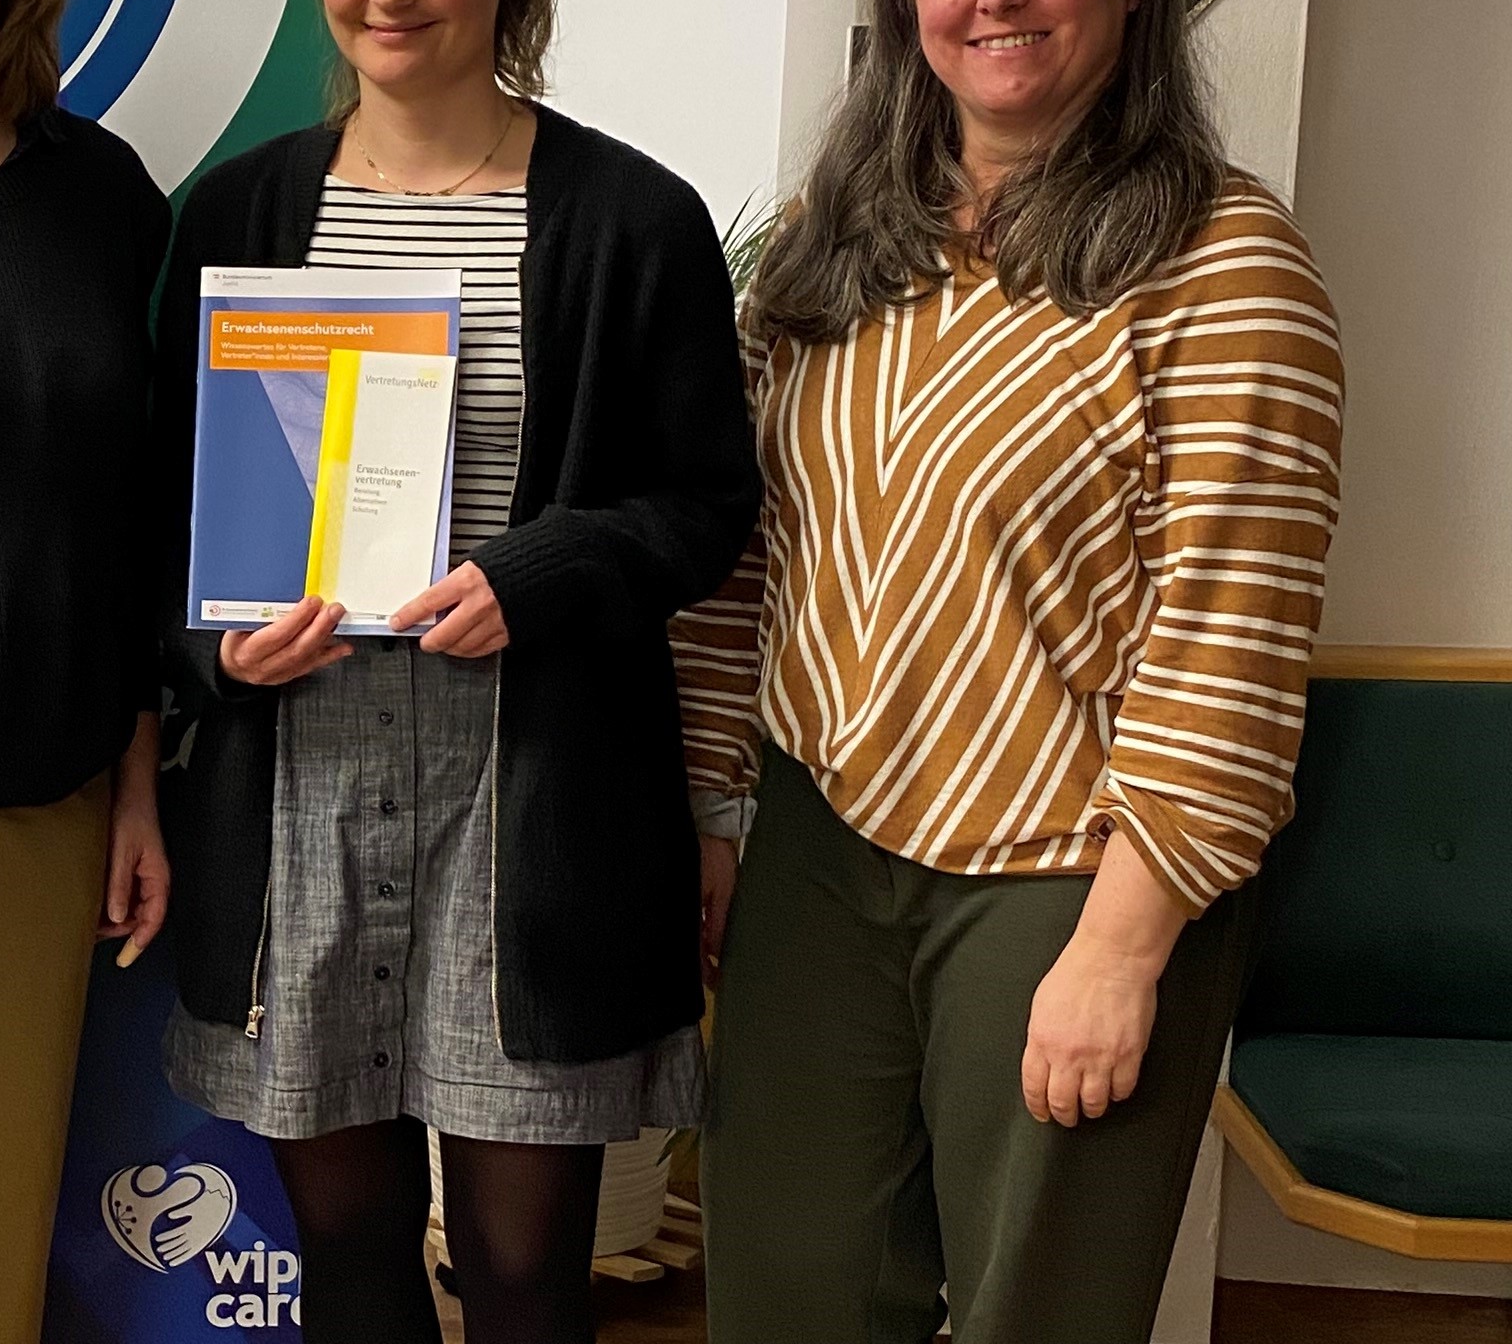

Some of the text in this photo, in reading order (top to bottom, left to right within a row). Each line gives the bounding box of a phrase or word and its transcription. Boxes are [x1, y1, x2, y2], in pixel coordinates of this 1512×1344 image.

[221, 321, 375, 336] Erwachsenenschutzrecht
[356, 463, 421, 477] Erwachsenen-
[355, 476, 403, 489] vertretung
[205, 1240, 302, 1294] wip
